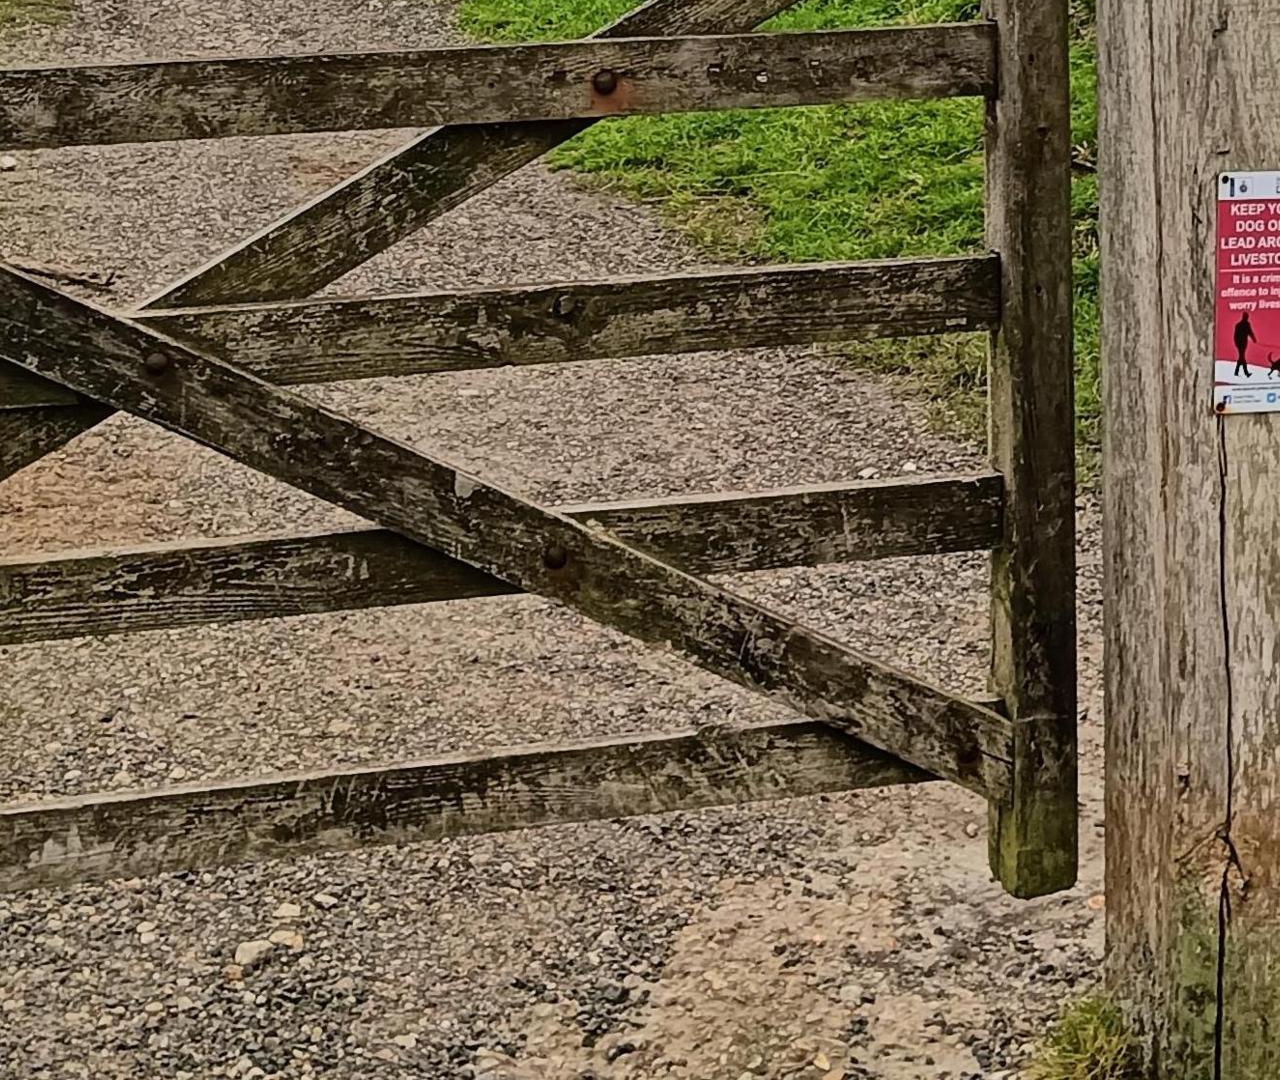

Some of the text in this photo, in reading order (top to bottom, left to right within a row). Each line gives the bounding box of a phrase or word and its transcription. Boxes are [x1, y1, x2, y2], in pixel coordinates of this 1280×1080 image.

[1230, 203, 1266, 216] KEEP
[1235, 219, 1265, 232] DOG
[1221, 237, 1256, 250] LEAD
[1232, 274, 1240, 284] It
[1241, 273, 1251, 284] is
[1252, 275, 1259, 284] a
[1221, 287, 1257, 298] offence
[1258, 287, 1269, 296] to
[1229, 301, 1257, 312] worry
